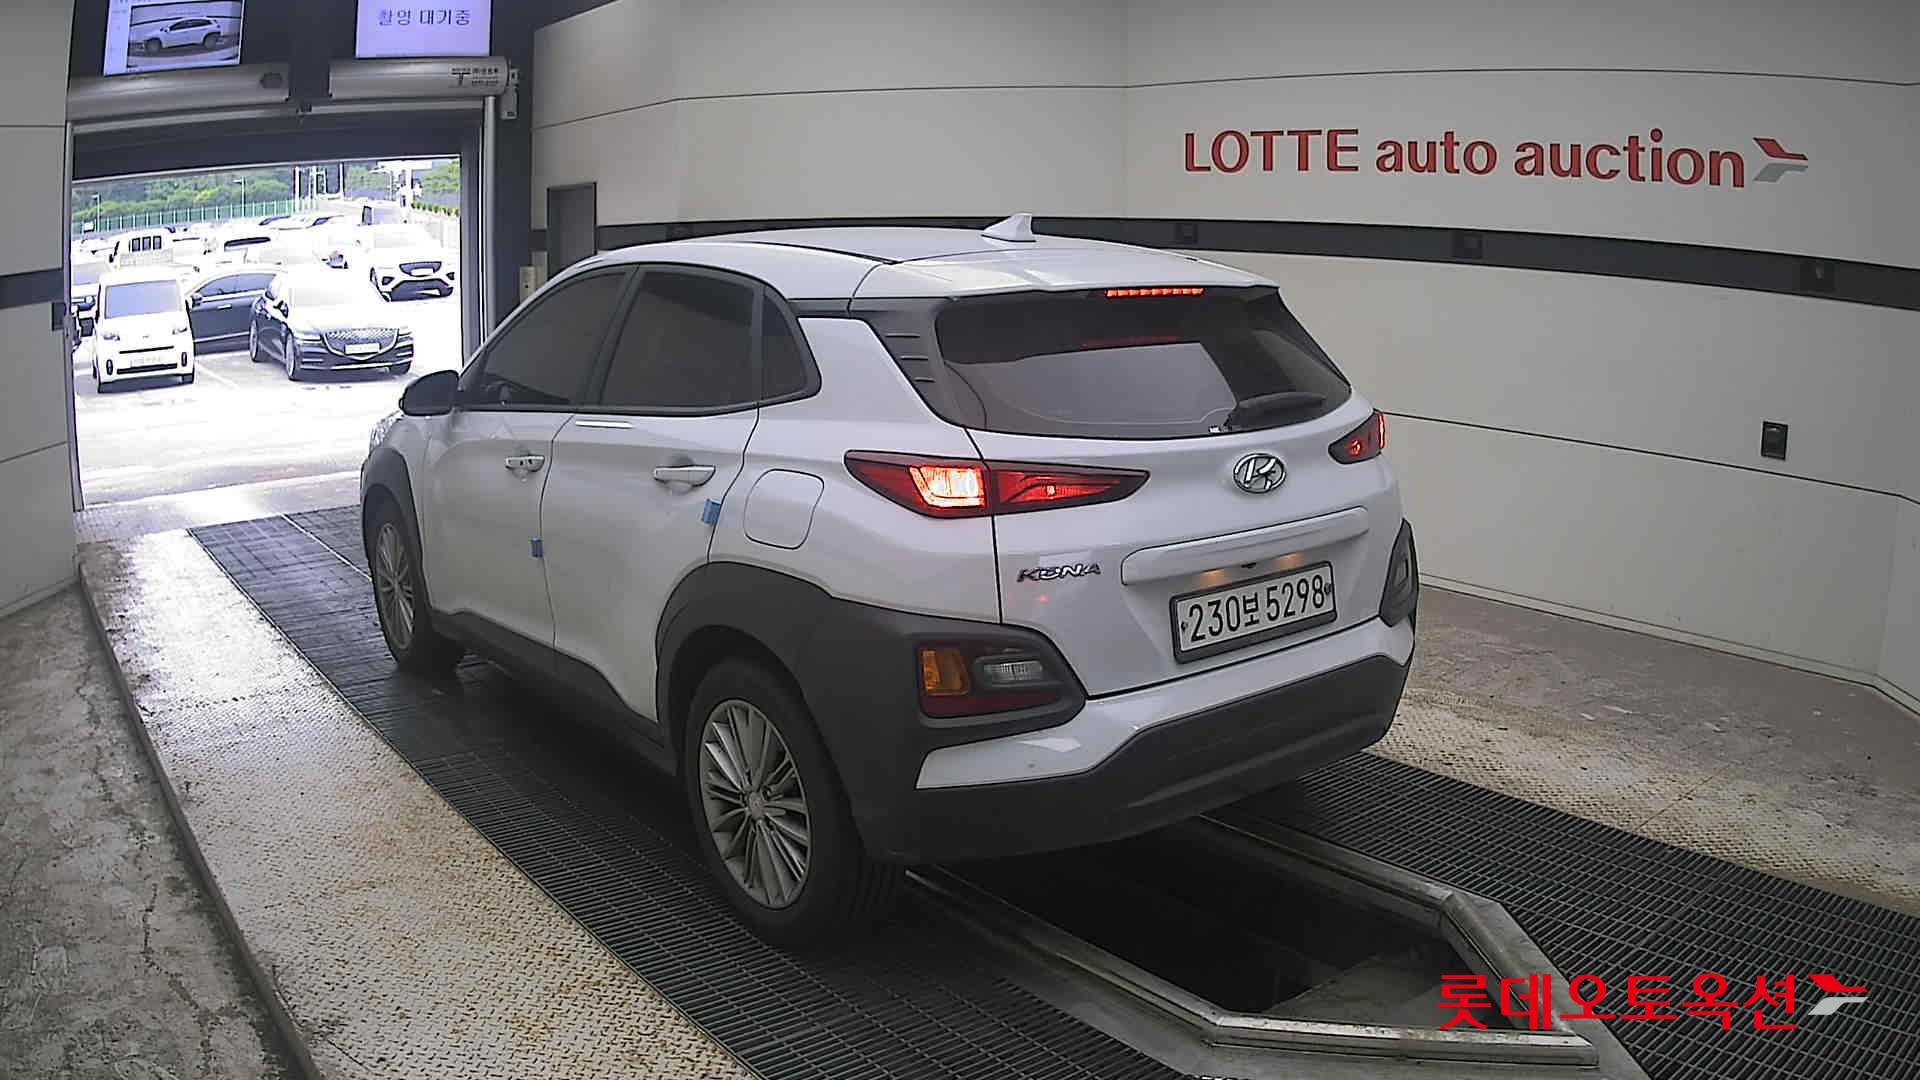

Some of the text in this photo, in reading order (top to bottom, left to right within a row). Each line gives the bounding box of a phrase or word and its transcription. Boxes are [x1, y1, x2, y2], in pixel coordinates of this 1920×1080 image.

[419, 9, 471, 26] 대기중
[1184, 128, 1745, 188] LOTTE auto auction
[1016, 563, 1101, 582] KONA
